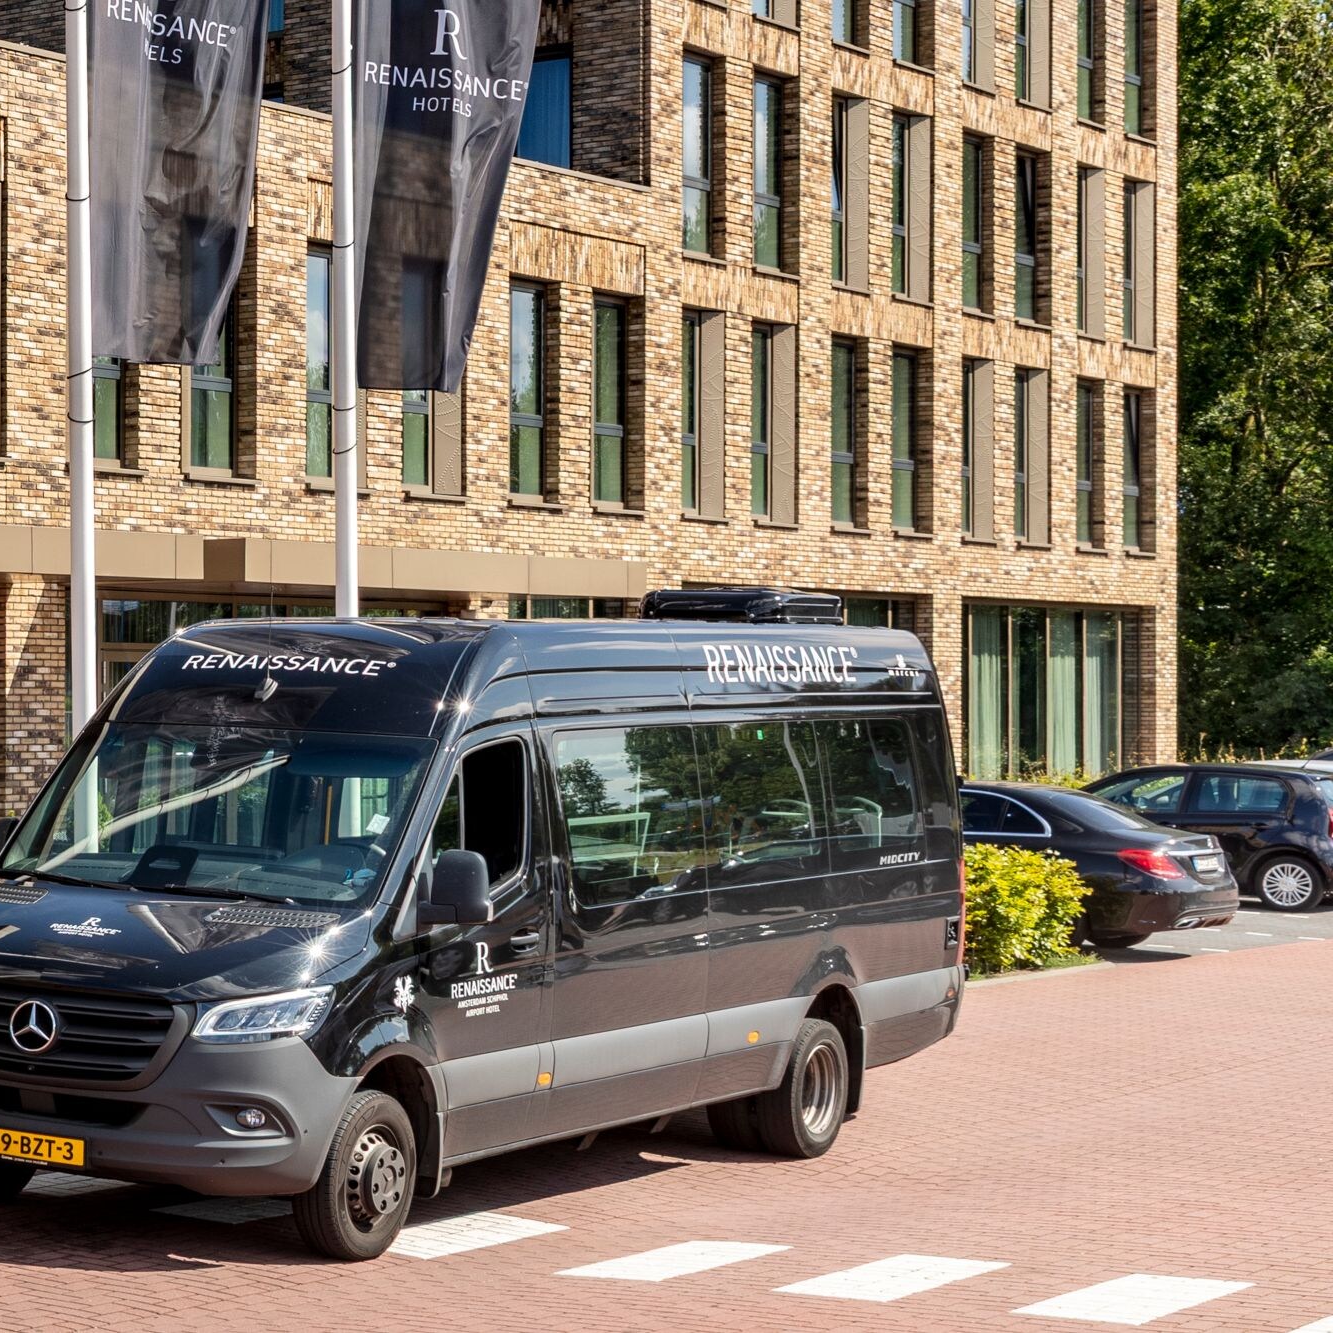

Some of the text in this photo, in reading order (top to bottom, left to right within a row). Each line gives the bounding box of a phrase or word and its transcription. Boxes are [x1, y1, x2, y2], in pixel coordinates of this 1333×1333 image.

[430, 9, 468, 60] R
[412, 97, 472, 118] HOTELS
[879, 851, 921, 866] MIDCITY
[475, 941, 494, 975] R
[457, 996, 487, 1009] AMSTERDAM
[485, 1004, 501, 1014] HOTEL
